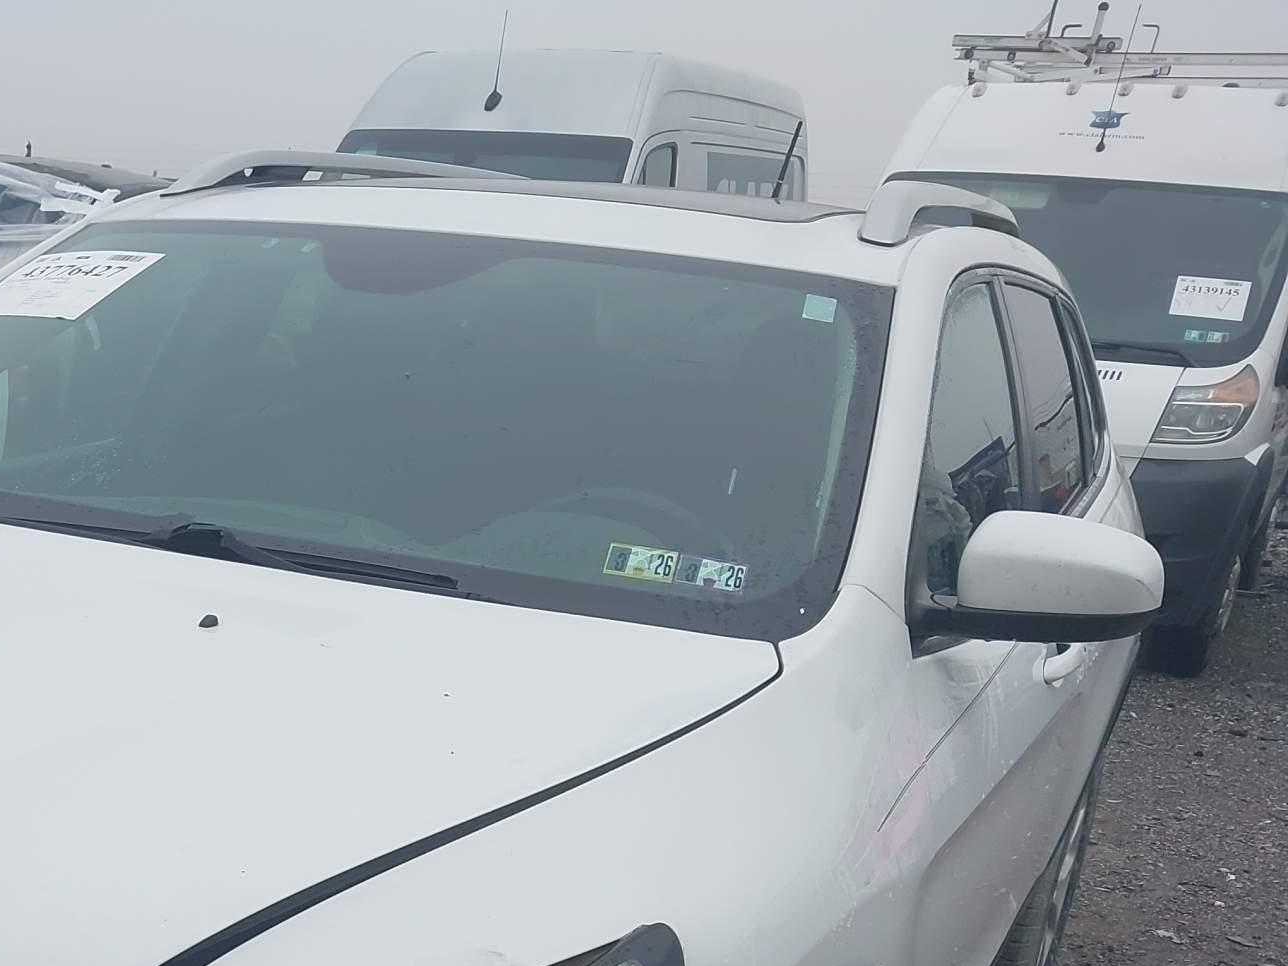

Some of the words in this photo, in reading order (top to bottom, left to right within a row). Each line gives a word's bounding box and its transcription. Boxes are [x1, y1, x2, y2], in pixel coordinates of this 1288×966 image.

[22, 264, 129, 279] 43776427
[1181, 285, 1241, 297] 43139145
[654, 554, 674, 577] 26
[724, 566, 745, 589] 26
